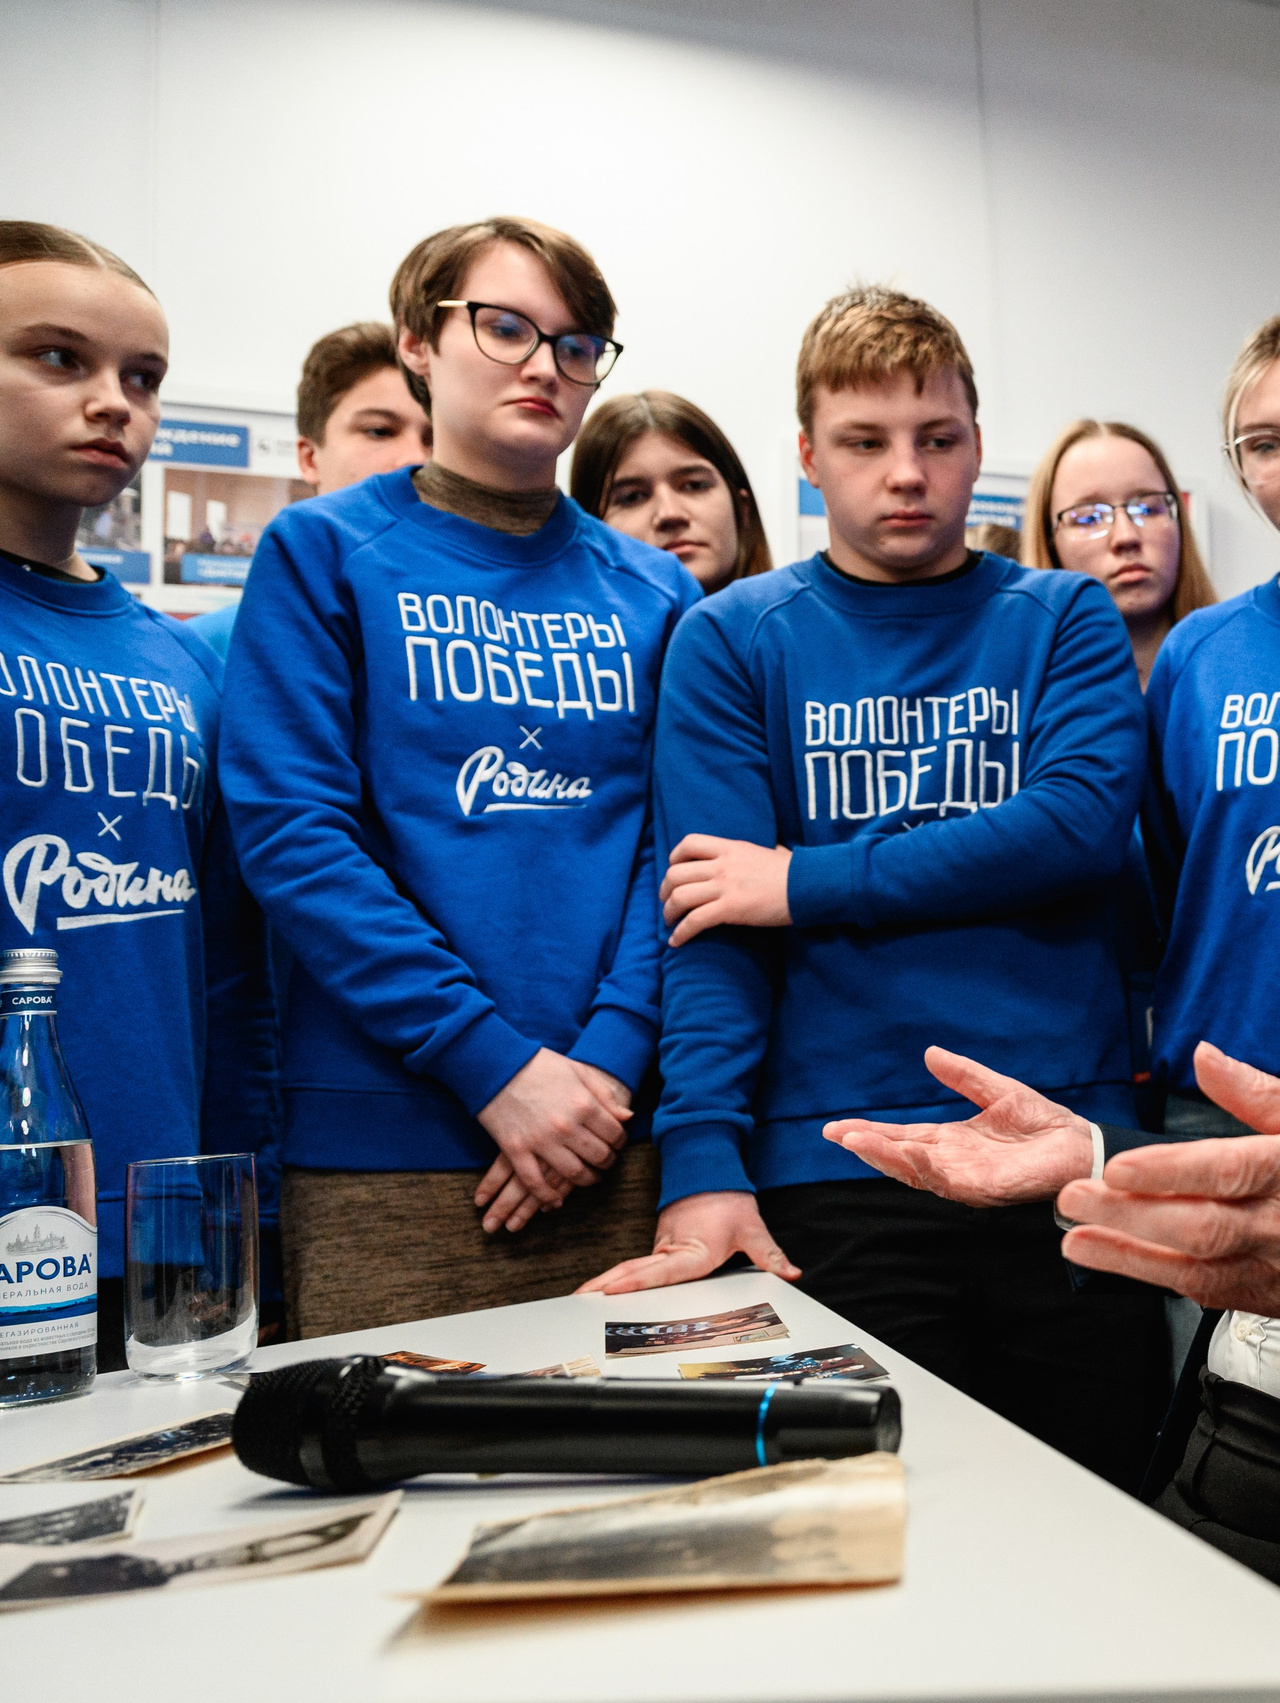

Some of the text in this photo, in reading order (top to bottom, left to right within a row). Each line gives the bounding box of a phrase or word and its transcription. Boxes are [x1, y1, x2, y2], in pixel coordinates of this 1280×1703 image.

[397, 592, 627, 649] ВОЛОНТЕРЫ
[405, 635, 636, 721] ПОБЕДЫ
[805, 686, 1019, 746] ВОЛОНТЕРЫ
[455, 745, 594, 818] Родина
[804, 738, 1020, 821] ПОБЕДЫ
[2, 834, 197, 936] Родина
[12, 996, 52, 1005] САРОВА
[2, 1281, 89, 1300] ЕРАЛЬНАЯ ВОДА
